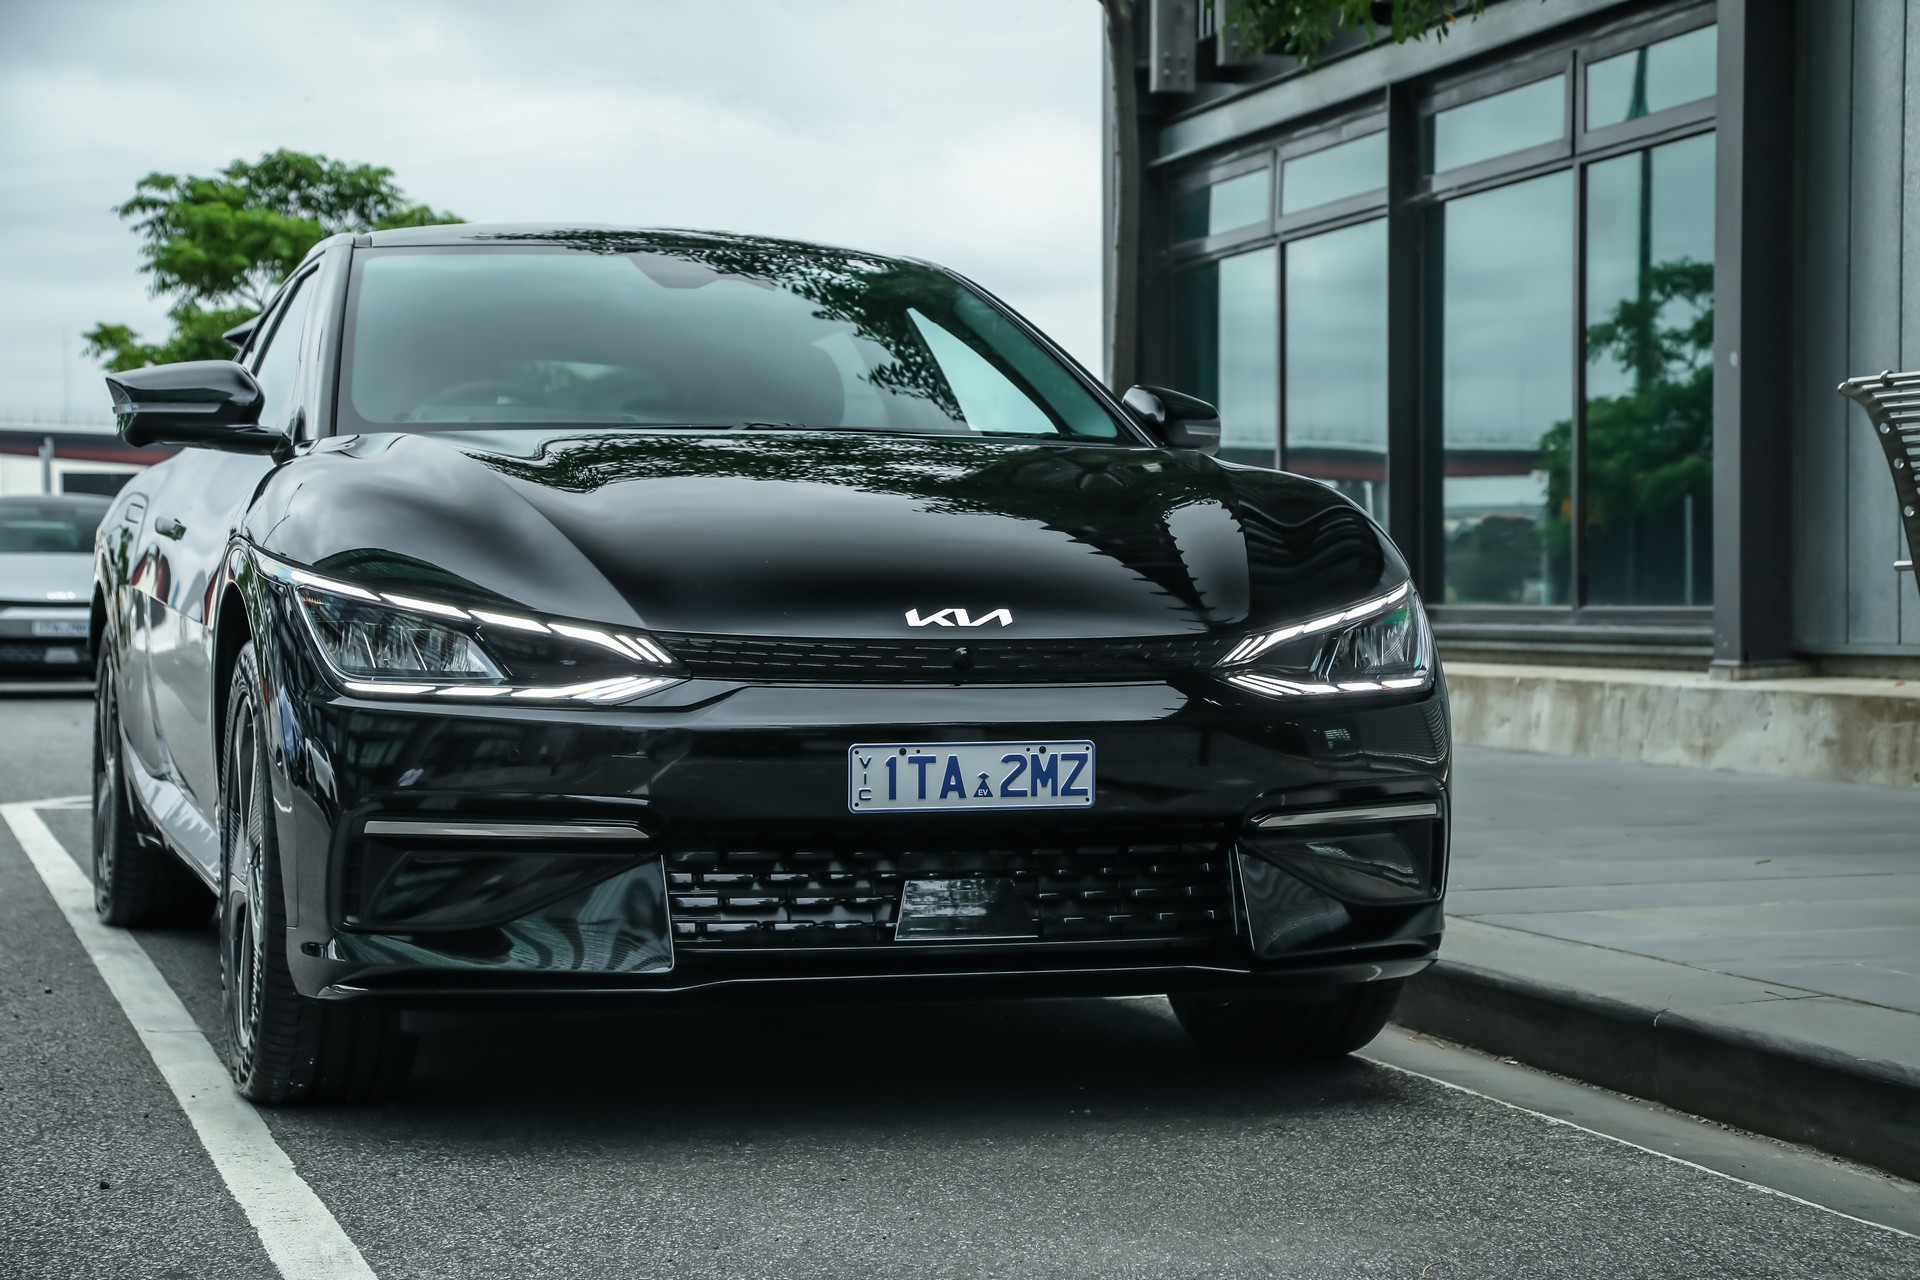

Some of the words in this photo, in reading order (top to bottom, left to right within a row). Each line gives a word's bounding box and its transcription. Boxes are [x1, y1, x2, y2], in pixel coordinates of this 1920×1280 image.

[905, 608, 1013, 627] KIA
[858, 755, 872, 800] VIC
[885, 755, 966, 800] 1TA
[1000, 753, 1088, 797] 2MZ
